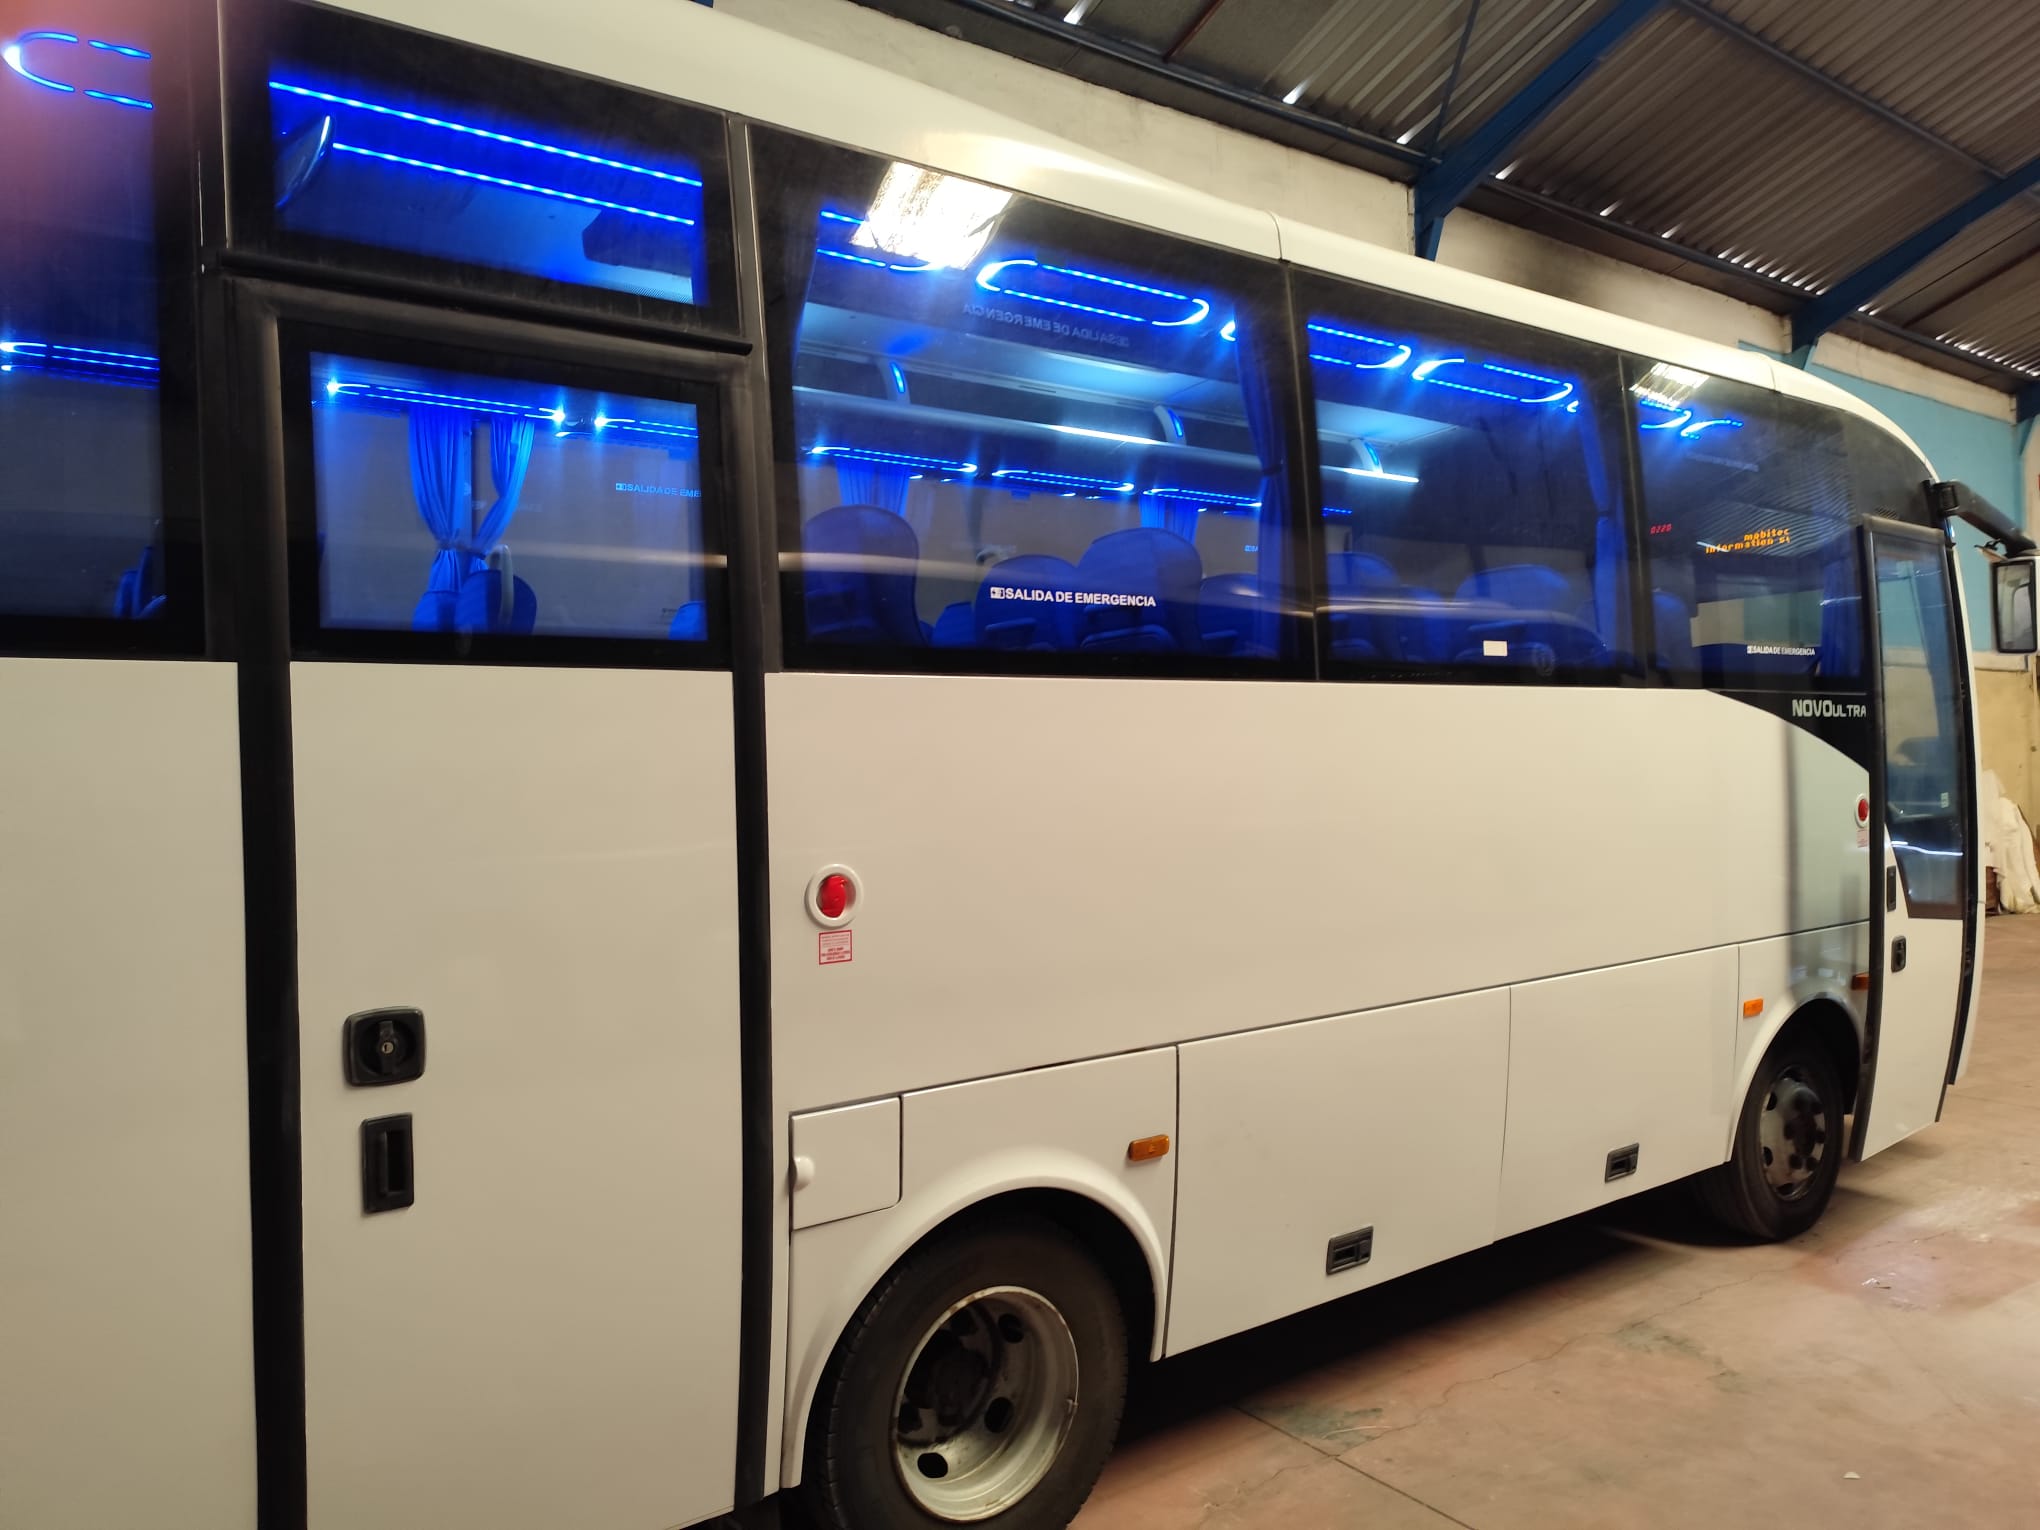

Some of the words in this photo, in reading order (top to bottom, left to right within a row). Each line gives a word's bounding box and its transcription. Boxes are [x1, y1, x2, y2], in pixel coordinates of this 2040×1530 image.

[1743, 528, 1789, 542] mobitec
[1005, 587, 1054, 602] SALIDA
[1055, 591, 1073, 603] DE
[1075, 592, 1157, 607] EMERGENCIA
[1753, 645, 1773, 655] SALIDA
